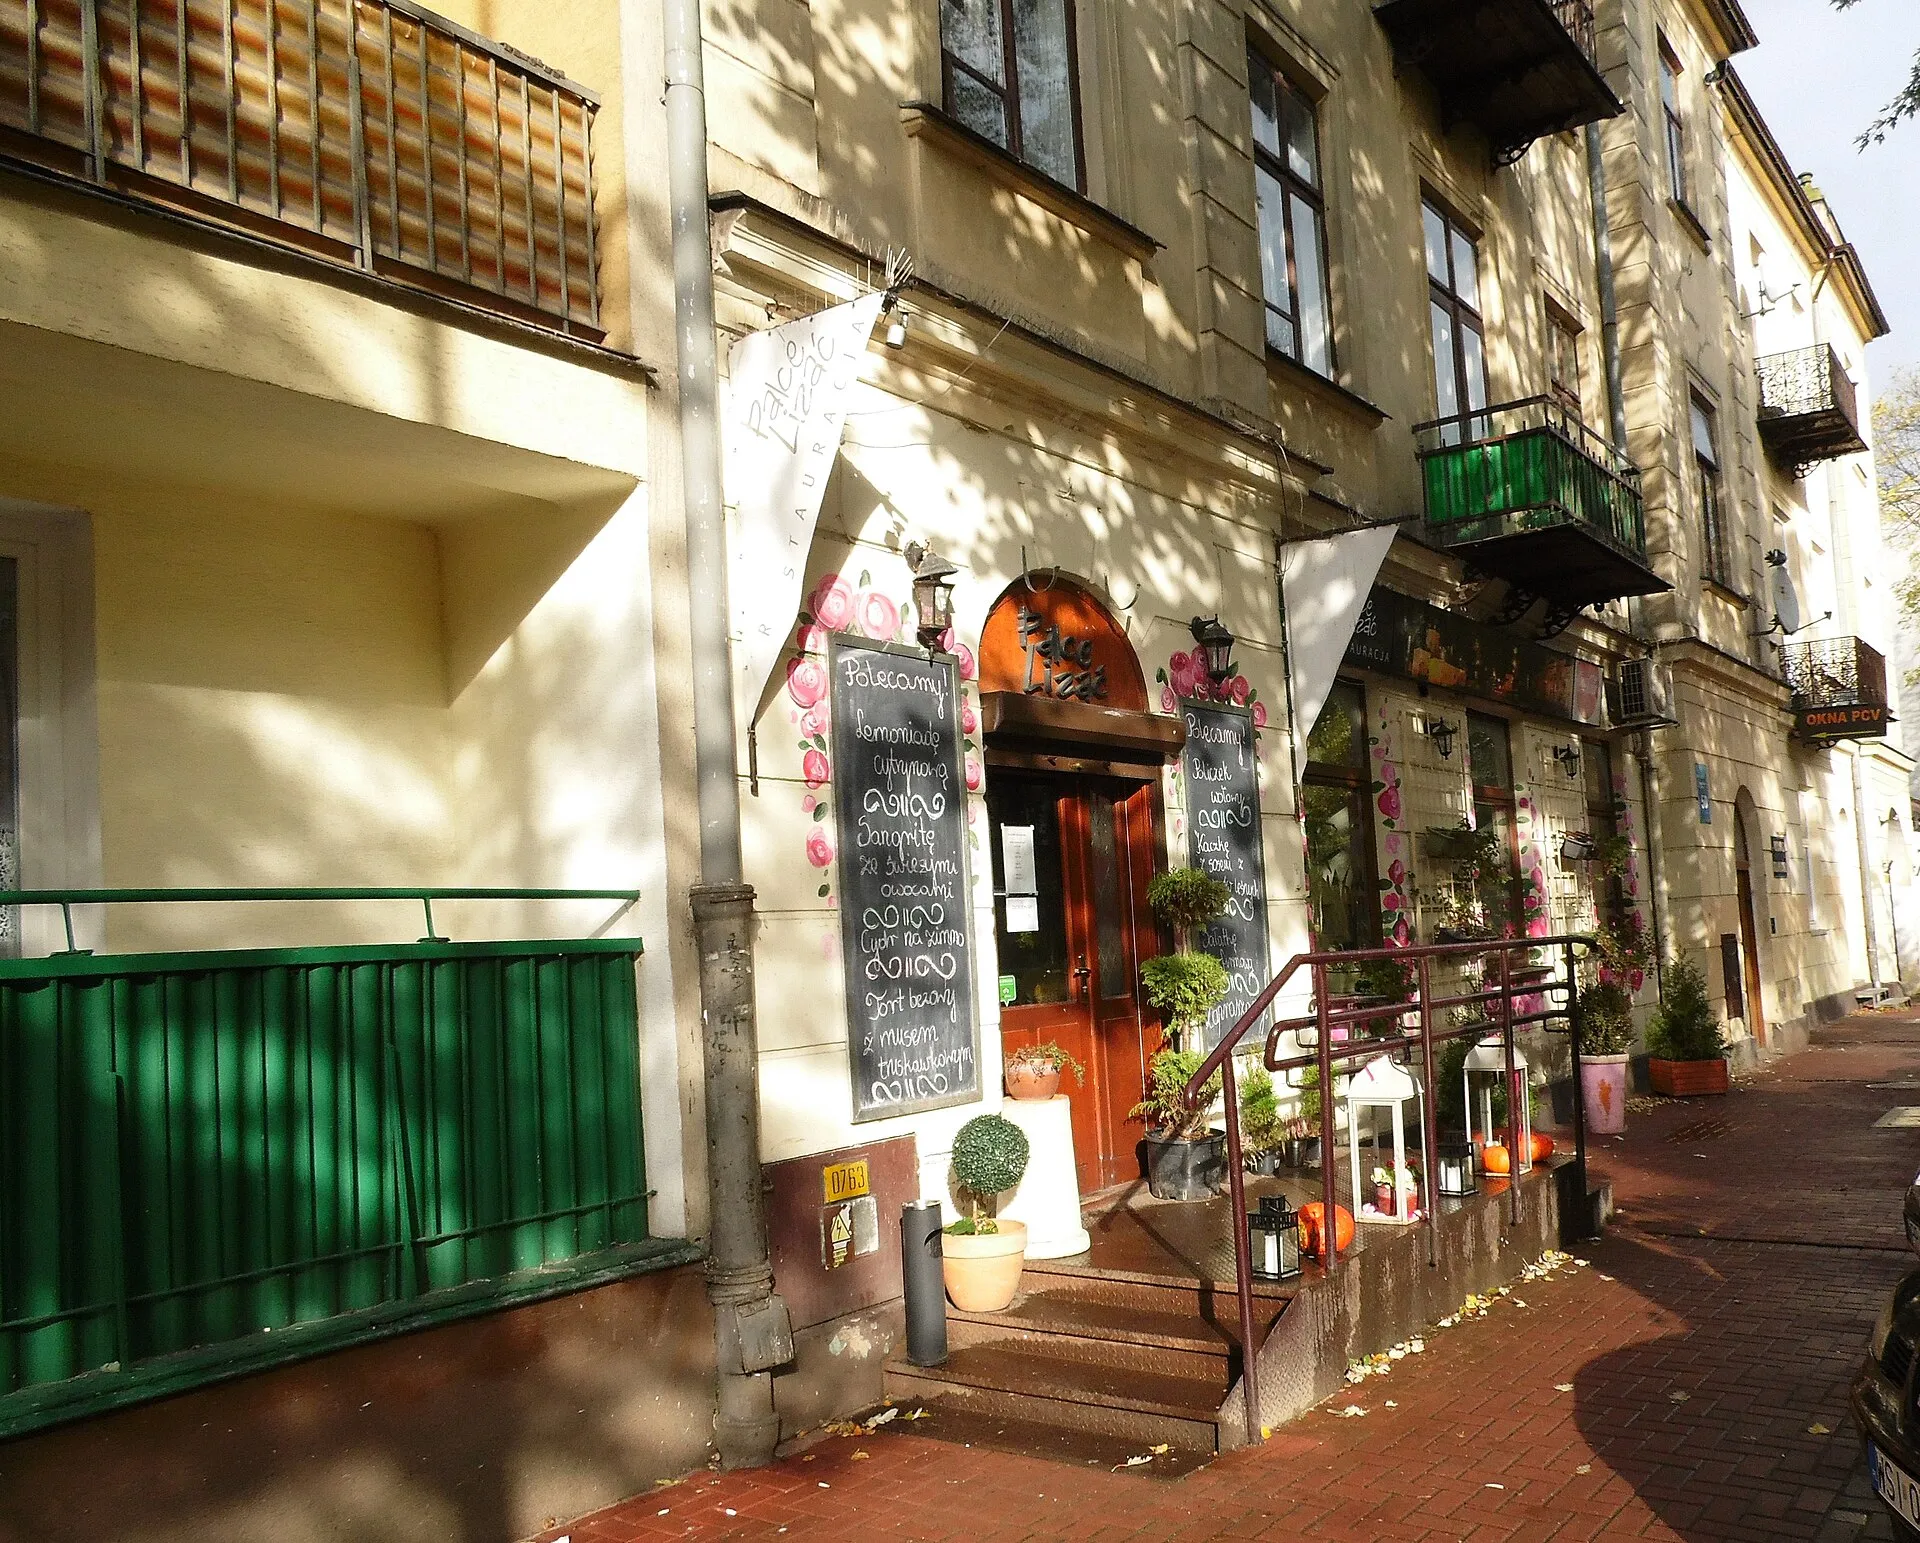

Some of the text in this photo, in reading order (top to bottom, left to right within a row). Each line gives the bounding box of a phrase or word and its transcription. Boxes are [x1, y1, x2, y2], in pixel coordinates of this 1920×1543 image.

[769, 332, 834, 454] Lizać
[839, 657, 949, 719] Polecamy!
[856, 709, 940, 755] Lemoniadę
[1806, 708, 1882, 726] OKNA PCV
[1186, 713, 1246, 766] Polecamy!
[881, 882, 954, 901] owocami
[904, 931, 923, 947] na
[866, 988, 904, 1020] Tort
[880, 1025, 939, 1047] musem
[831, 1166, 865, 1195] 0763
